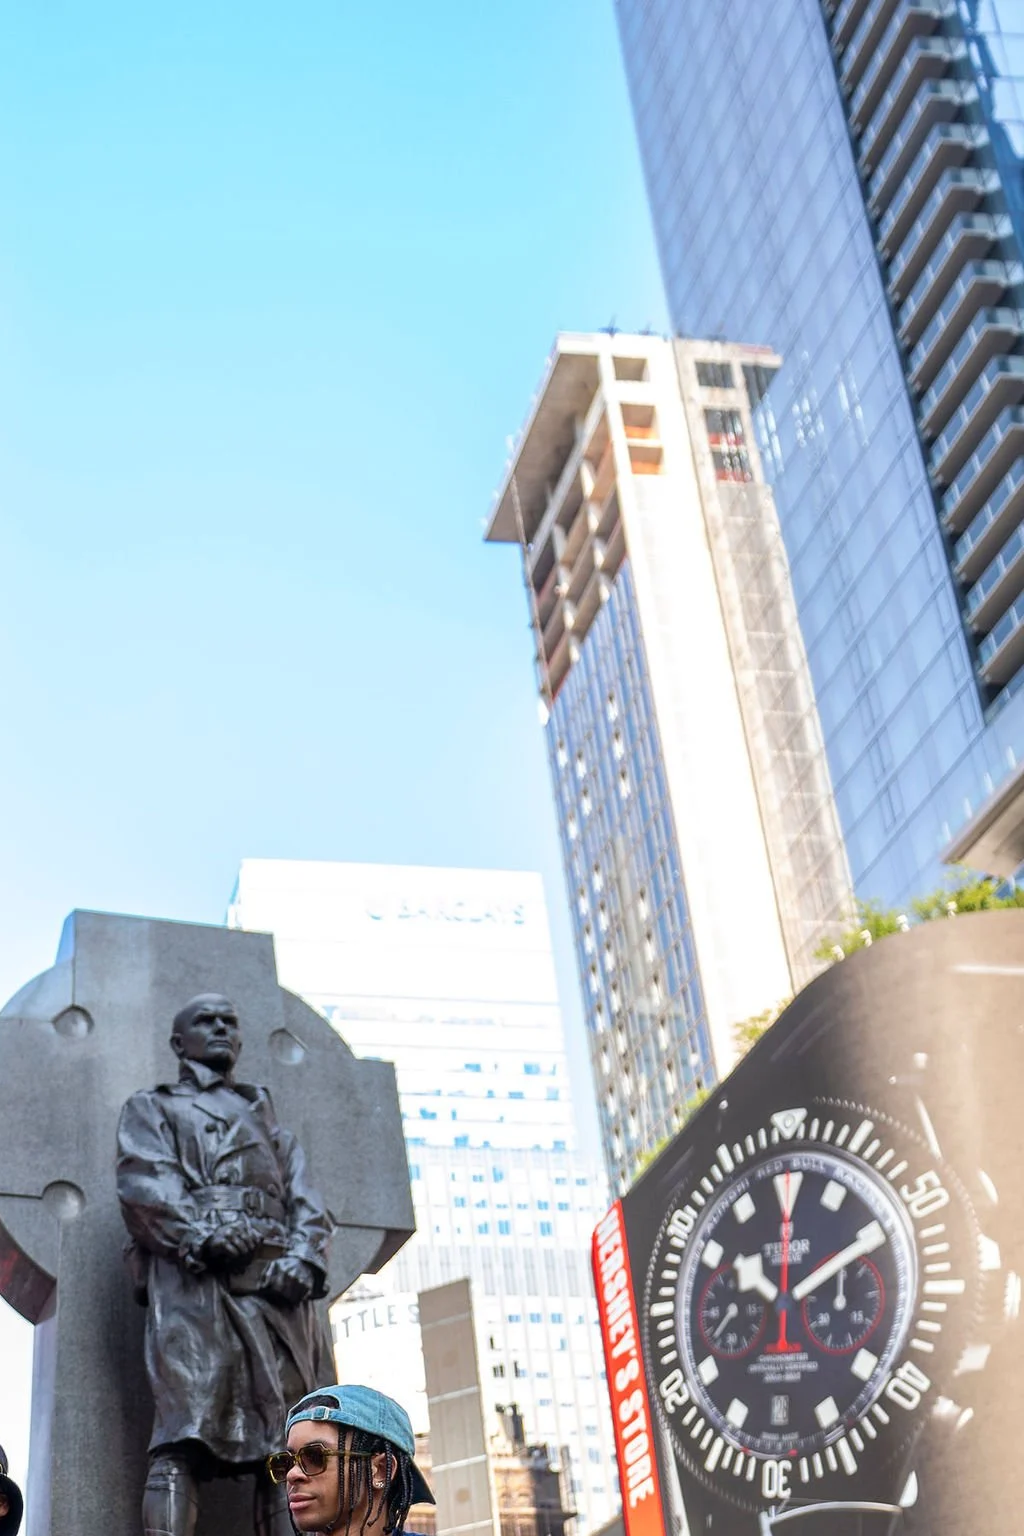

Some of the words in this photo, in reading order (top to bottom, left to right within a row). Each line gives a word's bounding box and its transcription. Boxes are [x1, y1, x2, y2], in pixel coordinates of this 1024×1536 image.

[899, 1170, 950, 1218] 50
[594, 1207, 639, 1391] HERSHEY'S
[619, 1389, 655, 1508] STORE
[659, 1368, 690, 1414] 20
[885, 1360, 931, 1411] 40
[761, 1459, 793, 1499] 30
